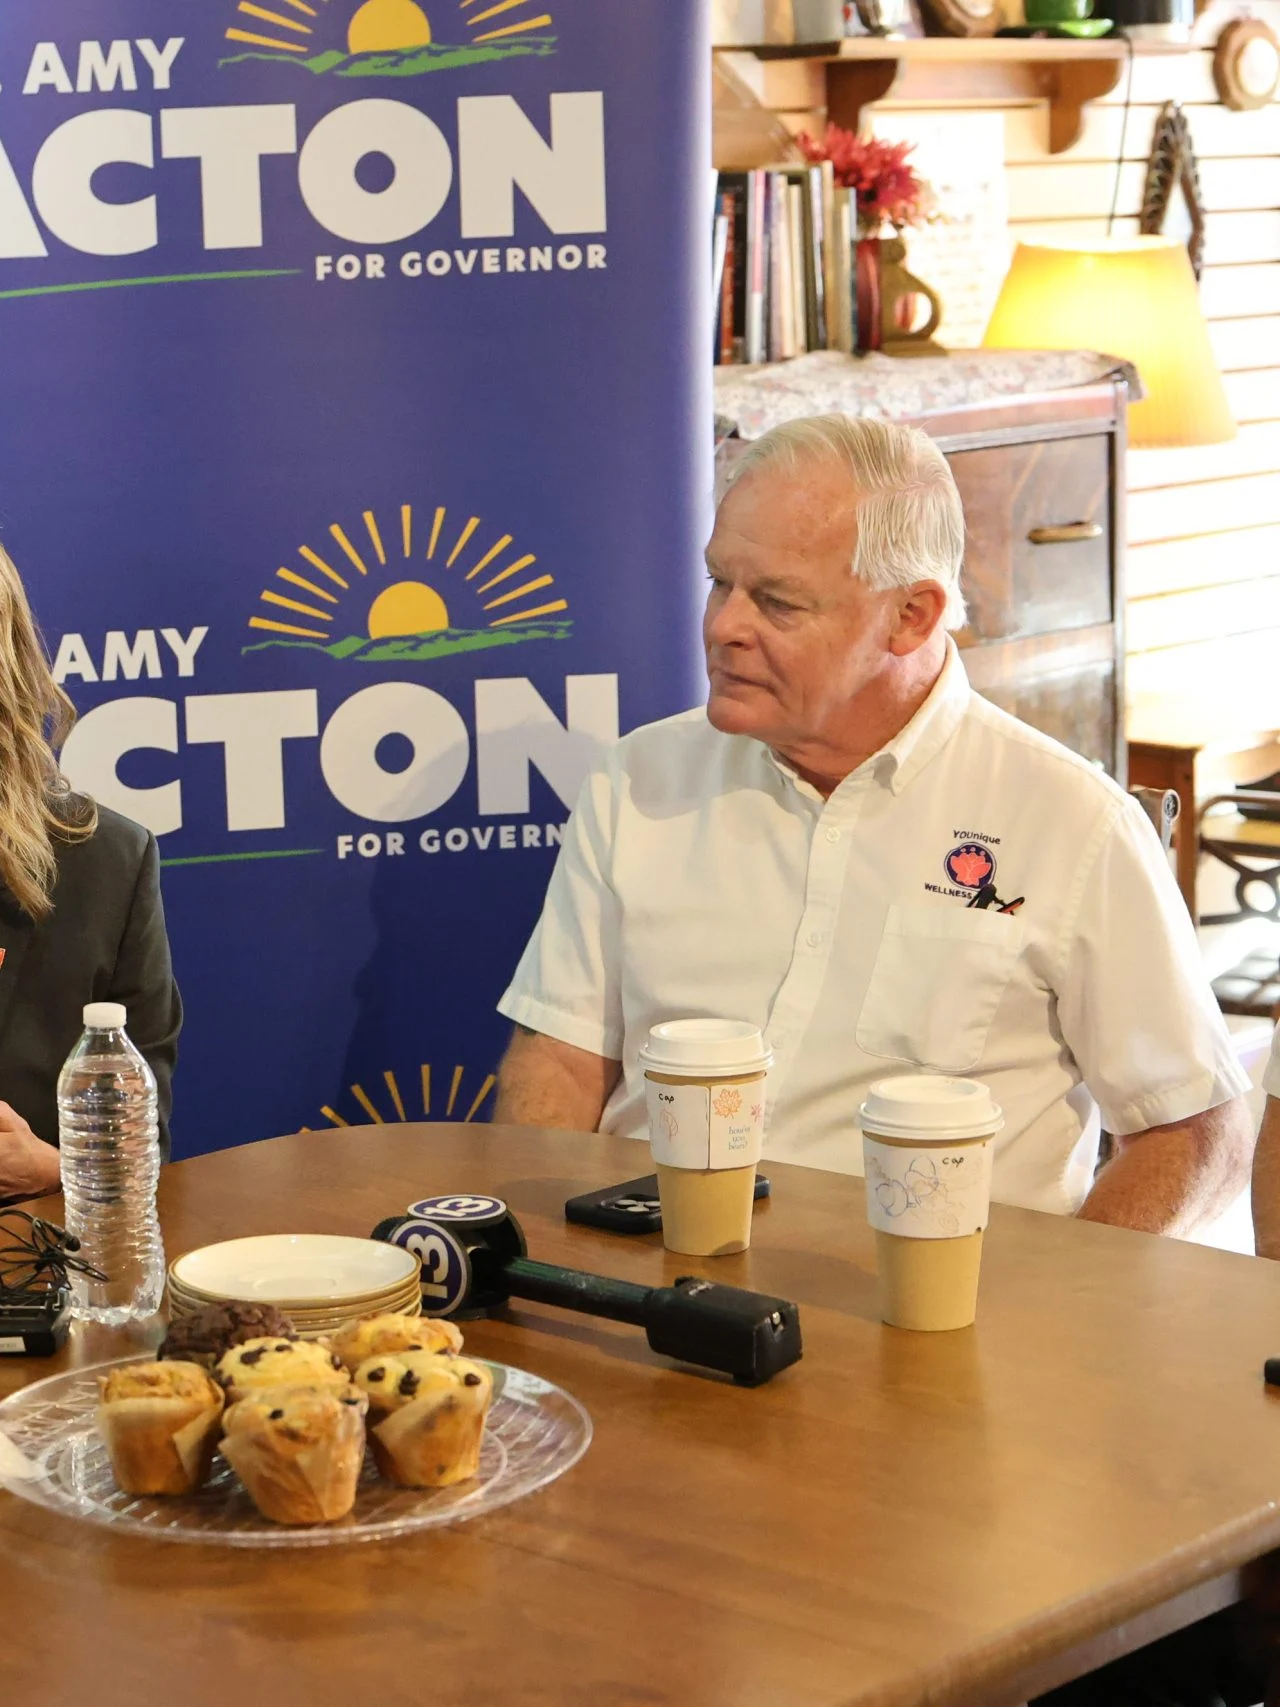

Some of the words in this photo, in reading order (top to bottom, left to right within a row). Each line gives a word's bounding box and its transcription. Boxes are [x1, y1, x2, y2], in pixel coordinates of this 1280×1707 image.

[22, 37, 185, 94] AMY
[315, 252, 386, 281] FOR
[400, 243, 608, 278] GOVERNOR
[51, 626, 209, 684] AMY
[58, 673, 619, 837] CTON
[337, 832, 406, 860] FOR
[419, 823, 566, 853] GOVERN
[952, 829, 1001, 845] YOUnique
[924, 882, 973, 900] WELLNESS
[423, 1197, 494, 1217] 13
